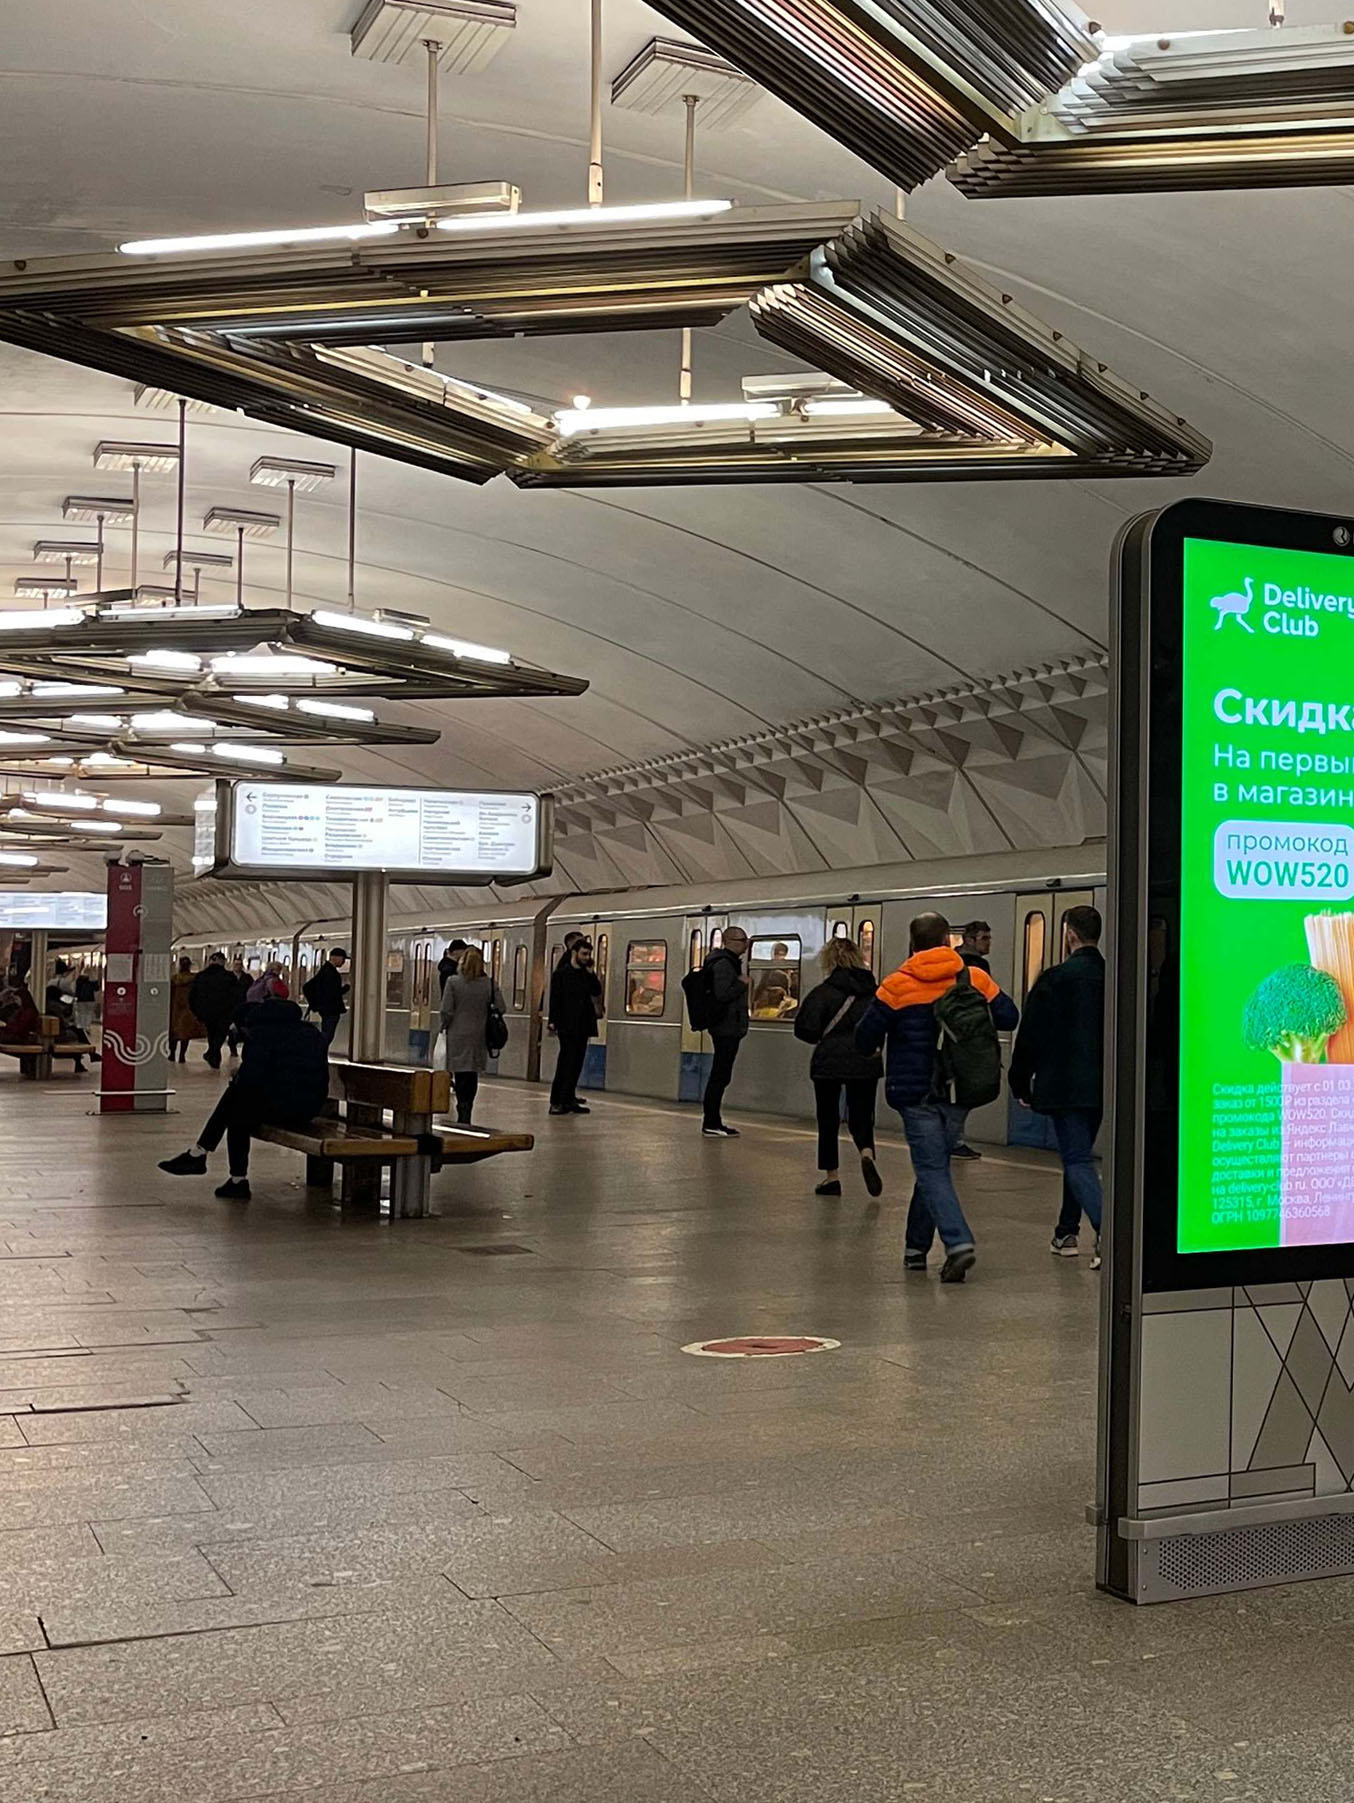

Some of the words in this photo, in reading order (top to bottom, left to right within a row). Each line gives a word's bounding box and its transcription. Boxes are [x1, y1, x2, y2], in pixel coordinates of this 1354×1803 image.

[1263, 611, 1319, 637] Club
[1213, 743, 1251, 771] На
[1213, 784, 1228, 803] в
[1227, 831, 1348, 857] промокод
[1227, 861, 1349, 888] WOW520
[1212, 1083, 1254, 1095] Скидка
[1256, 1082, 1311, 1095] действует
[1213, 1098, 1243, 1109] заказ
[1245, 1097, 1256, 1107] от
[1308, 1095, 1349, 1108] раздела
[1212, 1112, 1275, 1125] промокода
[1212, 1127, 1226, 1138] на
[1229, 1126, 1269, 1136] заказы
[1287, 1123, 1326, 1135] Яндекс
[1212, 1139, 1253, 1153] Delivery
[1256, 1138, 1281, 1149] Club
[1212, 1184, 1225, 1195] на
[1311, 1178, 1335, 1189] ООО
[1211, 1211, 1243, 1224] ОГРН
